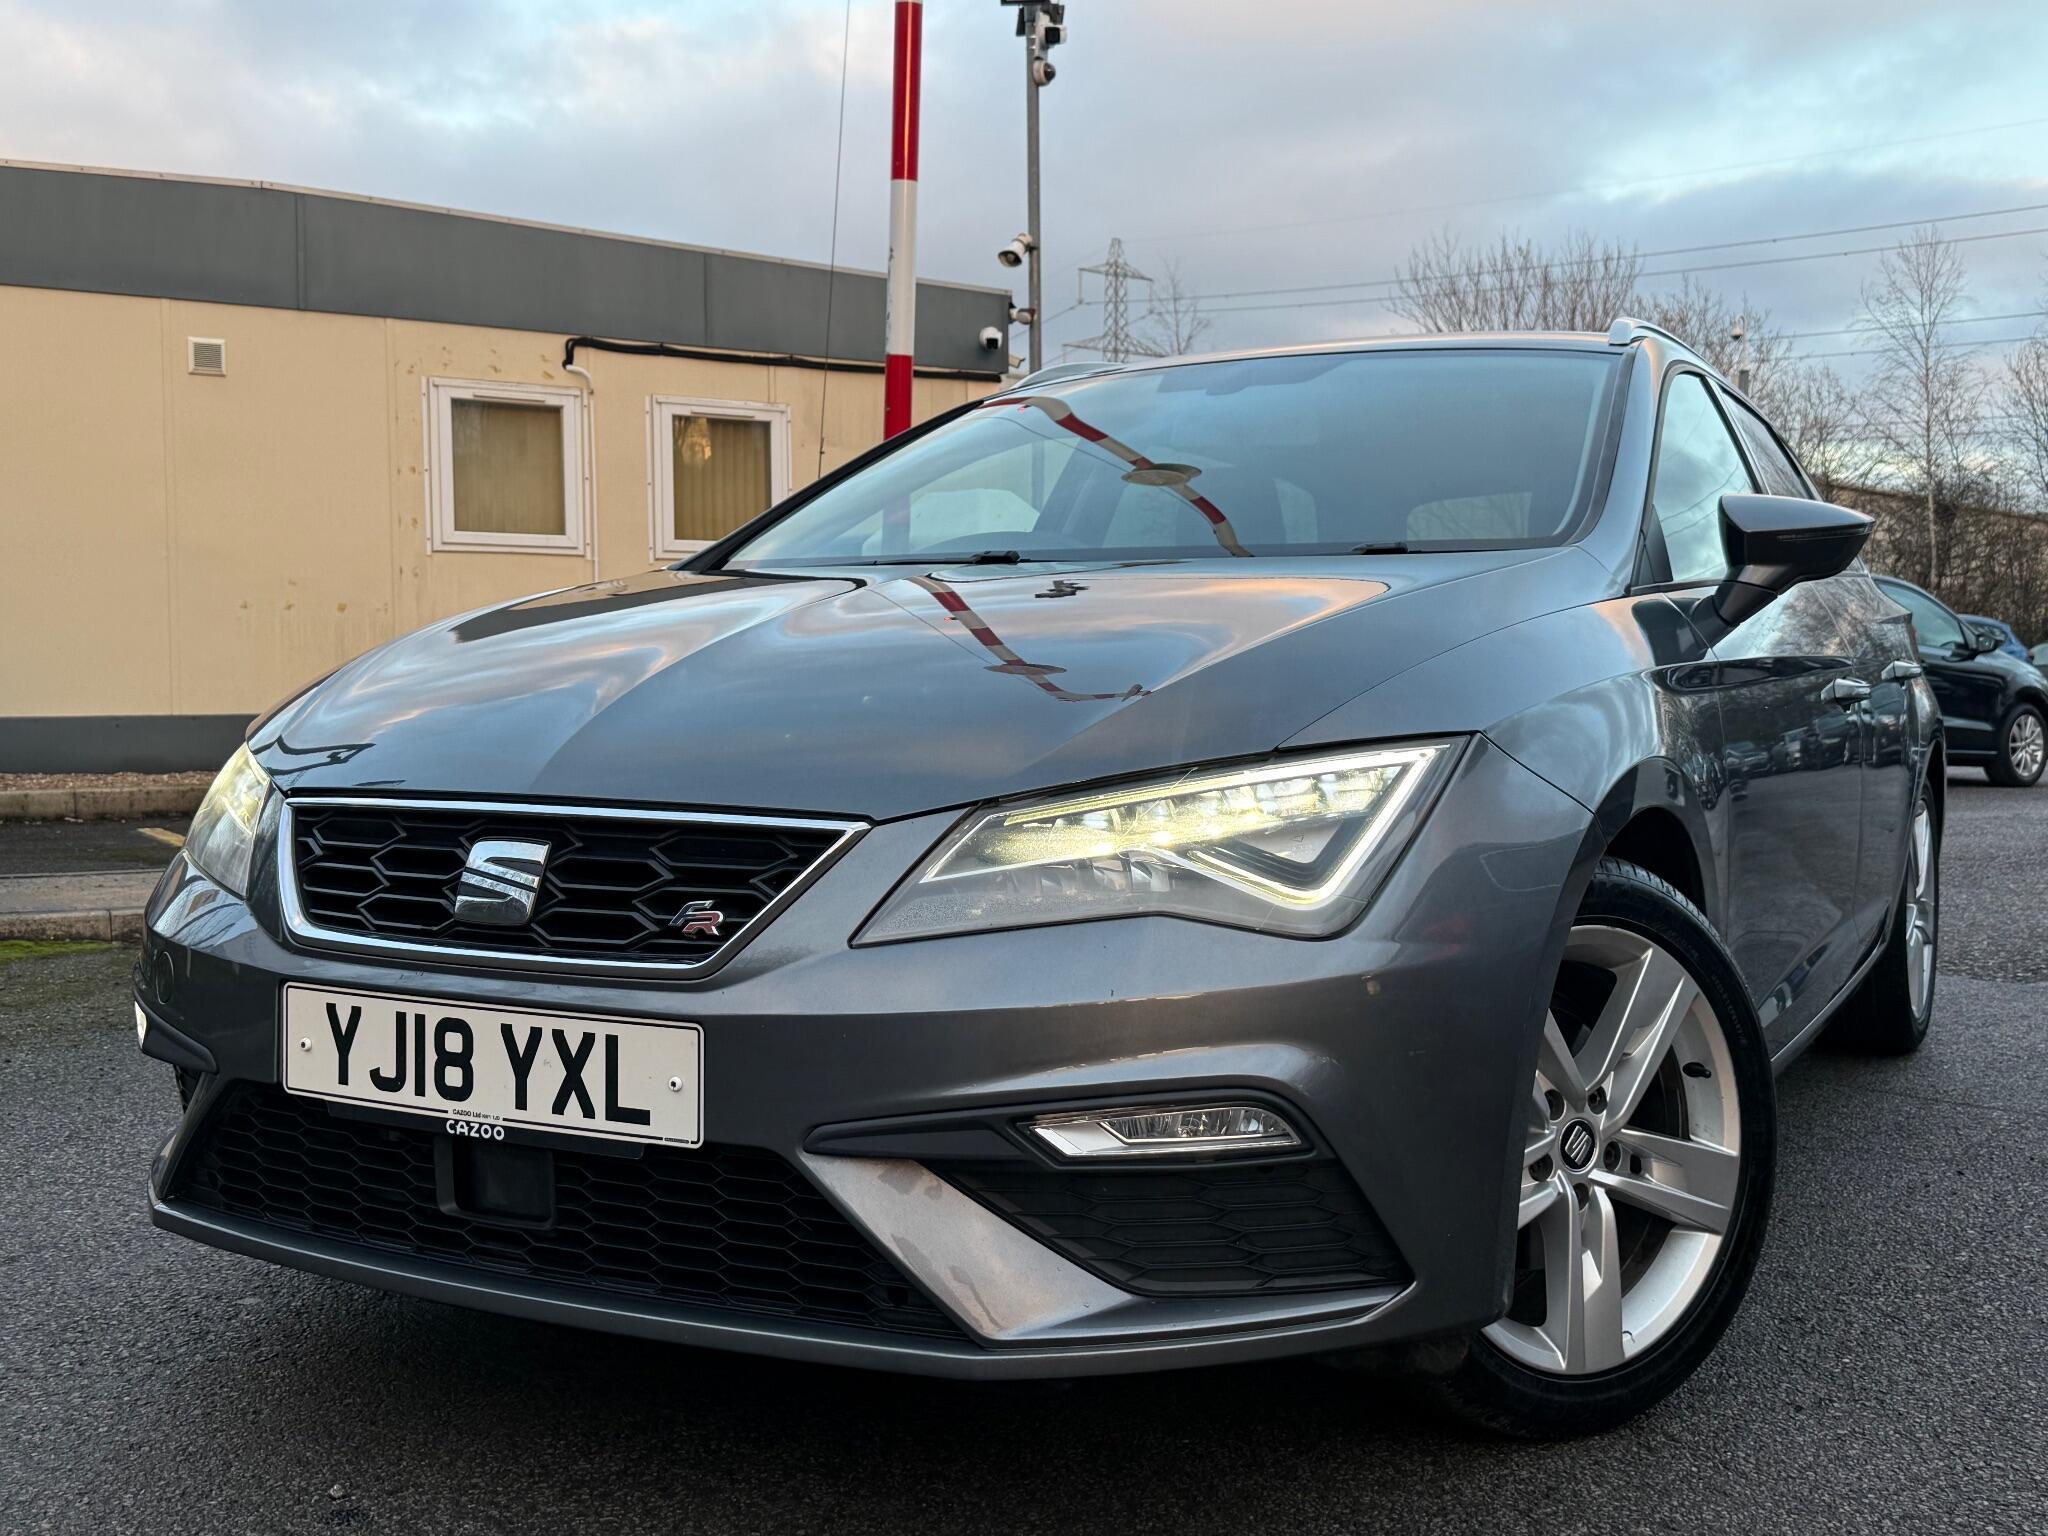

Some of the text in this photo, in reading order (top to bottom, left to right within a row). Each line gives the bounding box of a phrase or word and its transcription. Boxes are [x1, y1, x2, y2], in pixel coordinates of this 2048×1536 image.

[325, 1002, 651, 1126] YJ18 YXL
[452, 1109, 472, 1117] CAZOO
[446, 1119, 505, 1140] CAZOO
